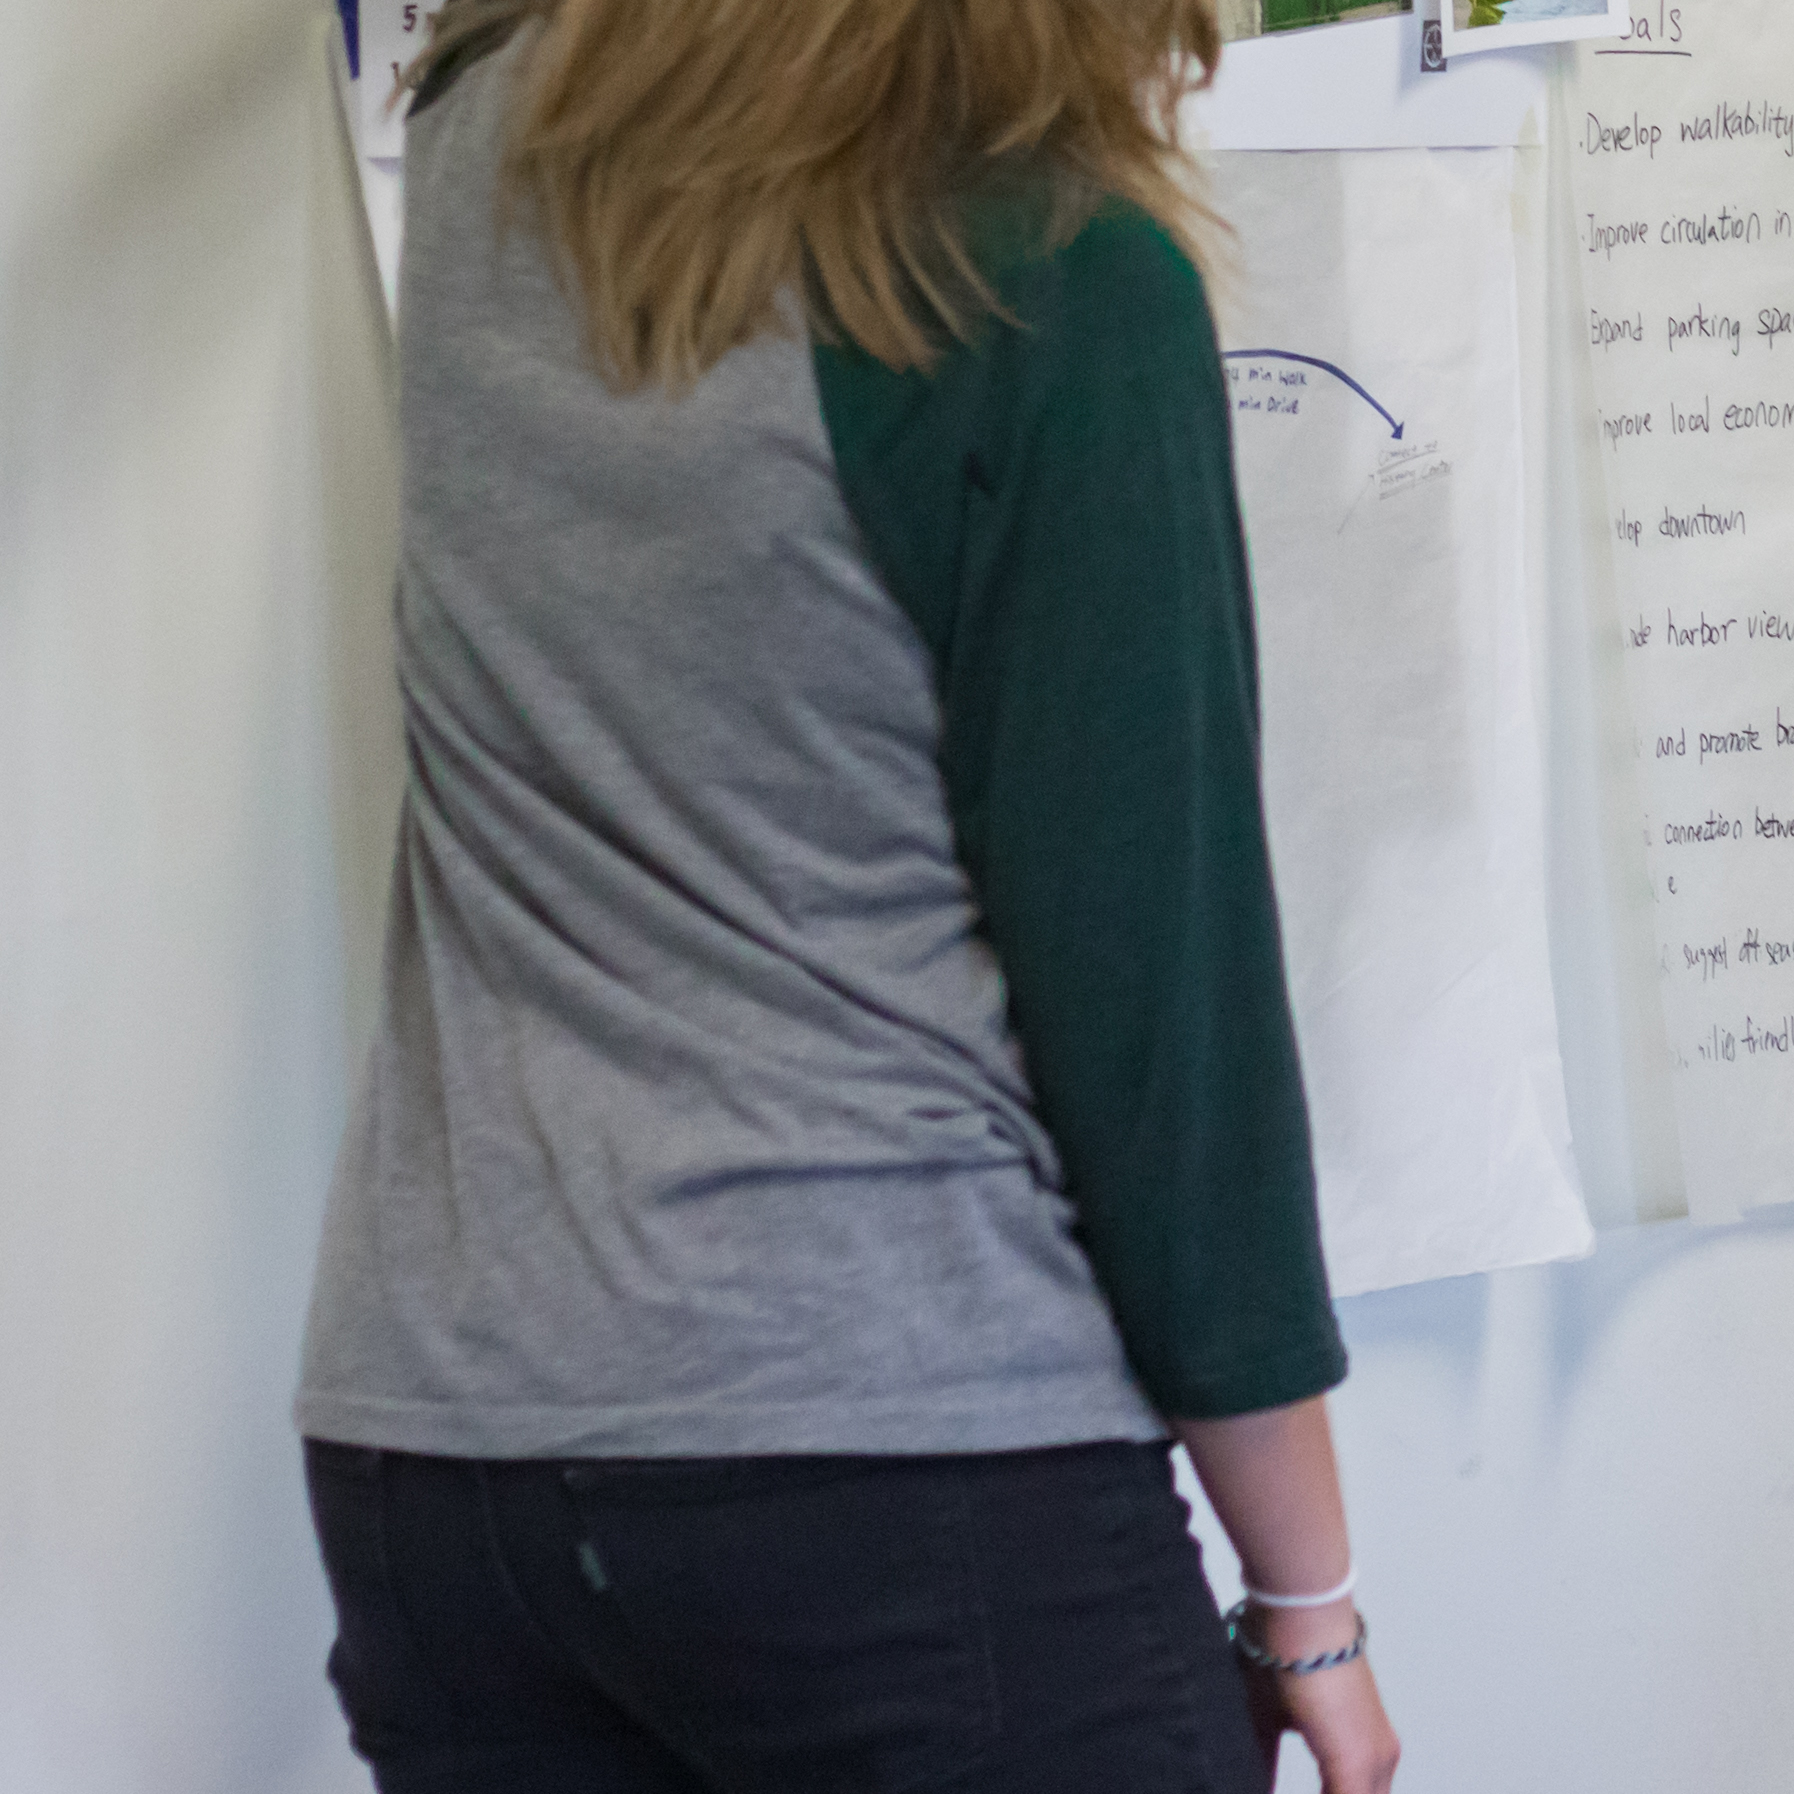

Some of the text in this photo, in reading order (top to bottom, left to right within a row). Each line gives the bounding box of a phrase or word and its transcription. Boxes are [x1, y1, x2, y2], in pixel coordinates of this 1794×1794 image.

[402, 4, 418, 33] 5
[1586, 110, 1663, 160] Develop
[1587, 212, 1649, 262] Improve
[1660, 205, 1762, 247] circulation
[1773, 207, 1794, 237] in
[1667, 302, 1742, 357] parking
[1670, 394, 1711, 435] local
[1658, 503, 1747, 539] downtown
[1667, 607, 1738, 648] harbor
[1655, 727, 1687, 759] and
[1699, 724, 1763, 765] promote
[1664, 808, 1743, 846] connection
[1683, 936, 1729, 983] suggest
